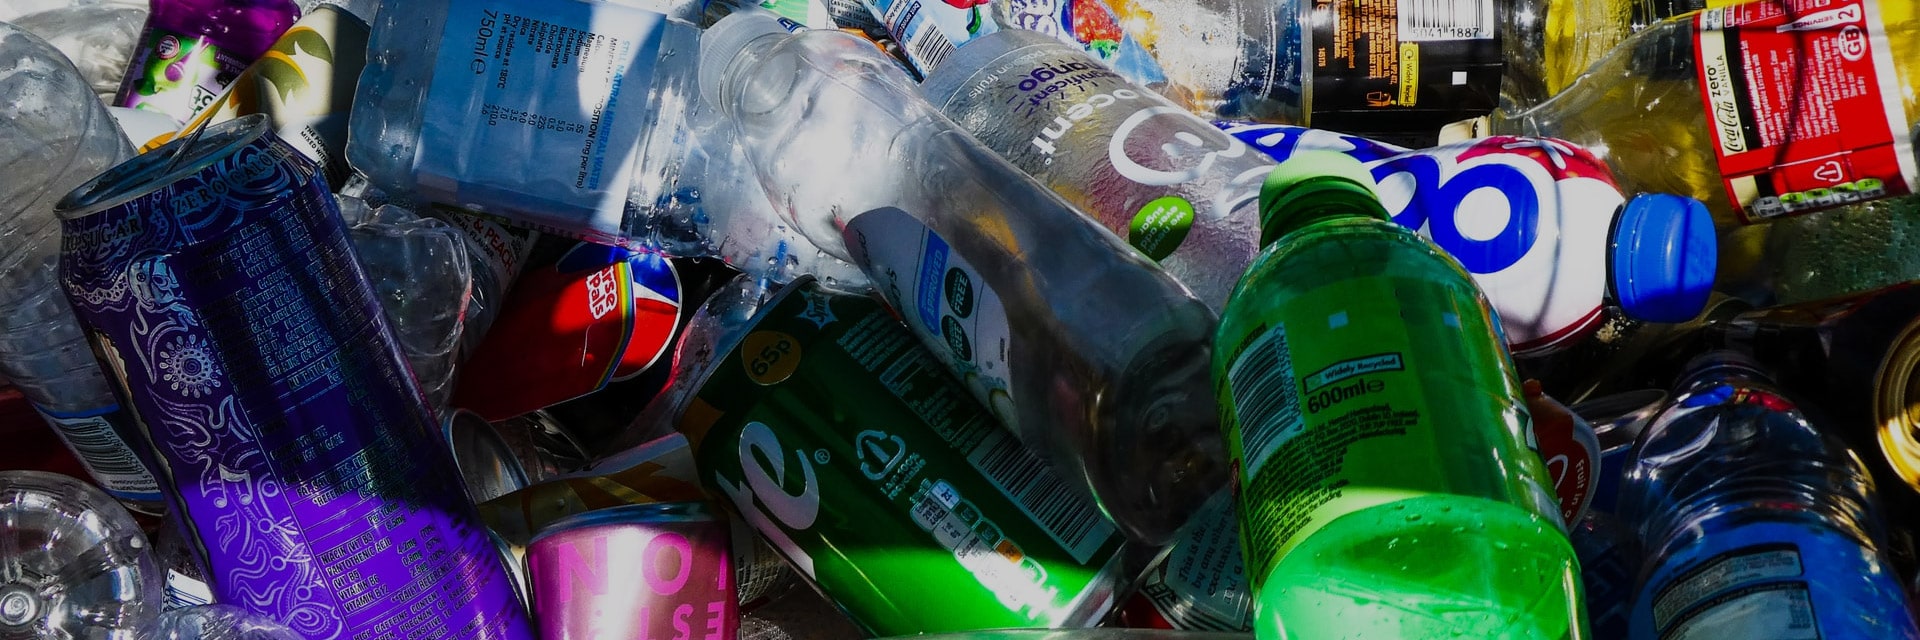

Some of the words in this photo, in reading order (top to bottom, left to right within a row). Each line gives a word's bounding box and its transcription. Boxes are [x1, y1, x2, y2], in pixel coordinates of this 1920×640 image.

[501, 13, 511, 25] pH
[509, 15, 520, 29] Dry
[519, 17, 529, 36] Silica
[1838, 8, 1854, 20] 2
[499, 26, 507, 34] at
[527, 19, 538, 46] Nitrate
[533, 21, 548, 53] Sulphate
[544, 24, 557, 54] Chloride
[1450, 27, 1479, 37] 1887
[1844, 28, 1861, 56] GB
[494, 35, 504, 59] source
[504, 29, 516, 57] residue
[550, 26, 567, 69] Bicarbonate
[561, 28, 575, 64] Potassium
[573, 30, 585, 57] Sodium
[502, 57, 509, 67] at
[1715, 52, 1730, 96] VANILLA
[606, 64, 624, 108] NATURAL
[966, 71, 999, 101] fruits
[1706, 66, 1721, 97] zero
[480, 102, 490, 115] 7.6
[487, 104, 499, 125] 210.0
[499, 106, 509, 119] 7.0
[509, 109, 518, 121] 3.5
[518, 111, 527, 124] 9.0
[527, 113, 536, 126] 9.0
[536, 115, 546, 129] 225
[546, 117, 555, 130] 0.5
[555, 119, 565, 132] 5.0
[565, 122, 574, 132] 15
[575, 123, 584, 134] 55
[595, 109, 613, 155] MINERAL
[582, 138, 593, 155] (mg
[578, 155, 588, 170] per
[587, 155, 603, 190] WATER
[574, 170, 587, 189] litre)
[171, 177, 227, 214] ZERO
[1137, 205, 1166, 235] sugar
[1157, 205, 1179, 227] ever
[1169, 209, 1187, 226] we
[471, 217, 488, 233] &
[481, 227, 514, 269] PEACH
[1139, 226, 1159, 248] add
[1146, 225, 1171, 254] never
[925, 249, 942, 315] APPROVED
[953, 274, 967, 313] FREE
[746, 333, 793, 379] 65p
[1575, 459, 1585, 488] Fruit
[1189, 524, 1205, 543] the
[320, 545, 347, 564] NIACIN
[325, 546, 375, 576] PANTOTHENIC
[1187, 543, 1198, 554] is
[1191, 571, 1205, 588] by
[1199, 545, 1215, 570] any
[1208, 516, 1226, 544] other
[1176, 555, 1195, 580] This
[337, 579, 369, 601] VITAMIN
[1218, 576, 1238, 603] and
[1232, 564, 1243, 575] a
[342, 591, 374, 613] VITAMIN
[373, 583, 390, 598] B12
[352, 626, 372, 640] HIGH
[372, 608, 409, 632] CAFFEINE
[410, 590, 440, 613] CONTENT
[398, 606, 435, 634] PREGNANT
[405, 614, 443, 640] SENSITIVE
